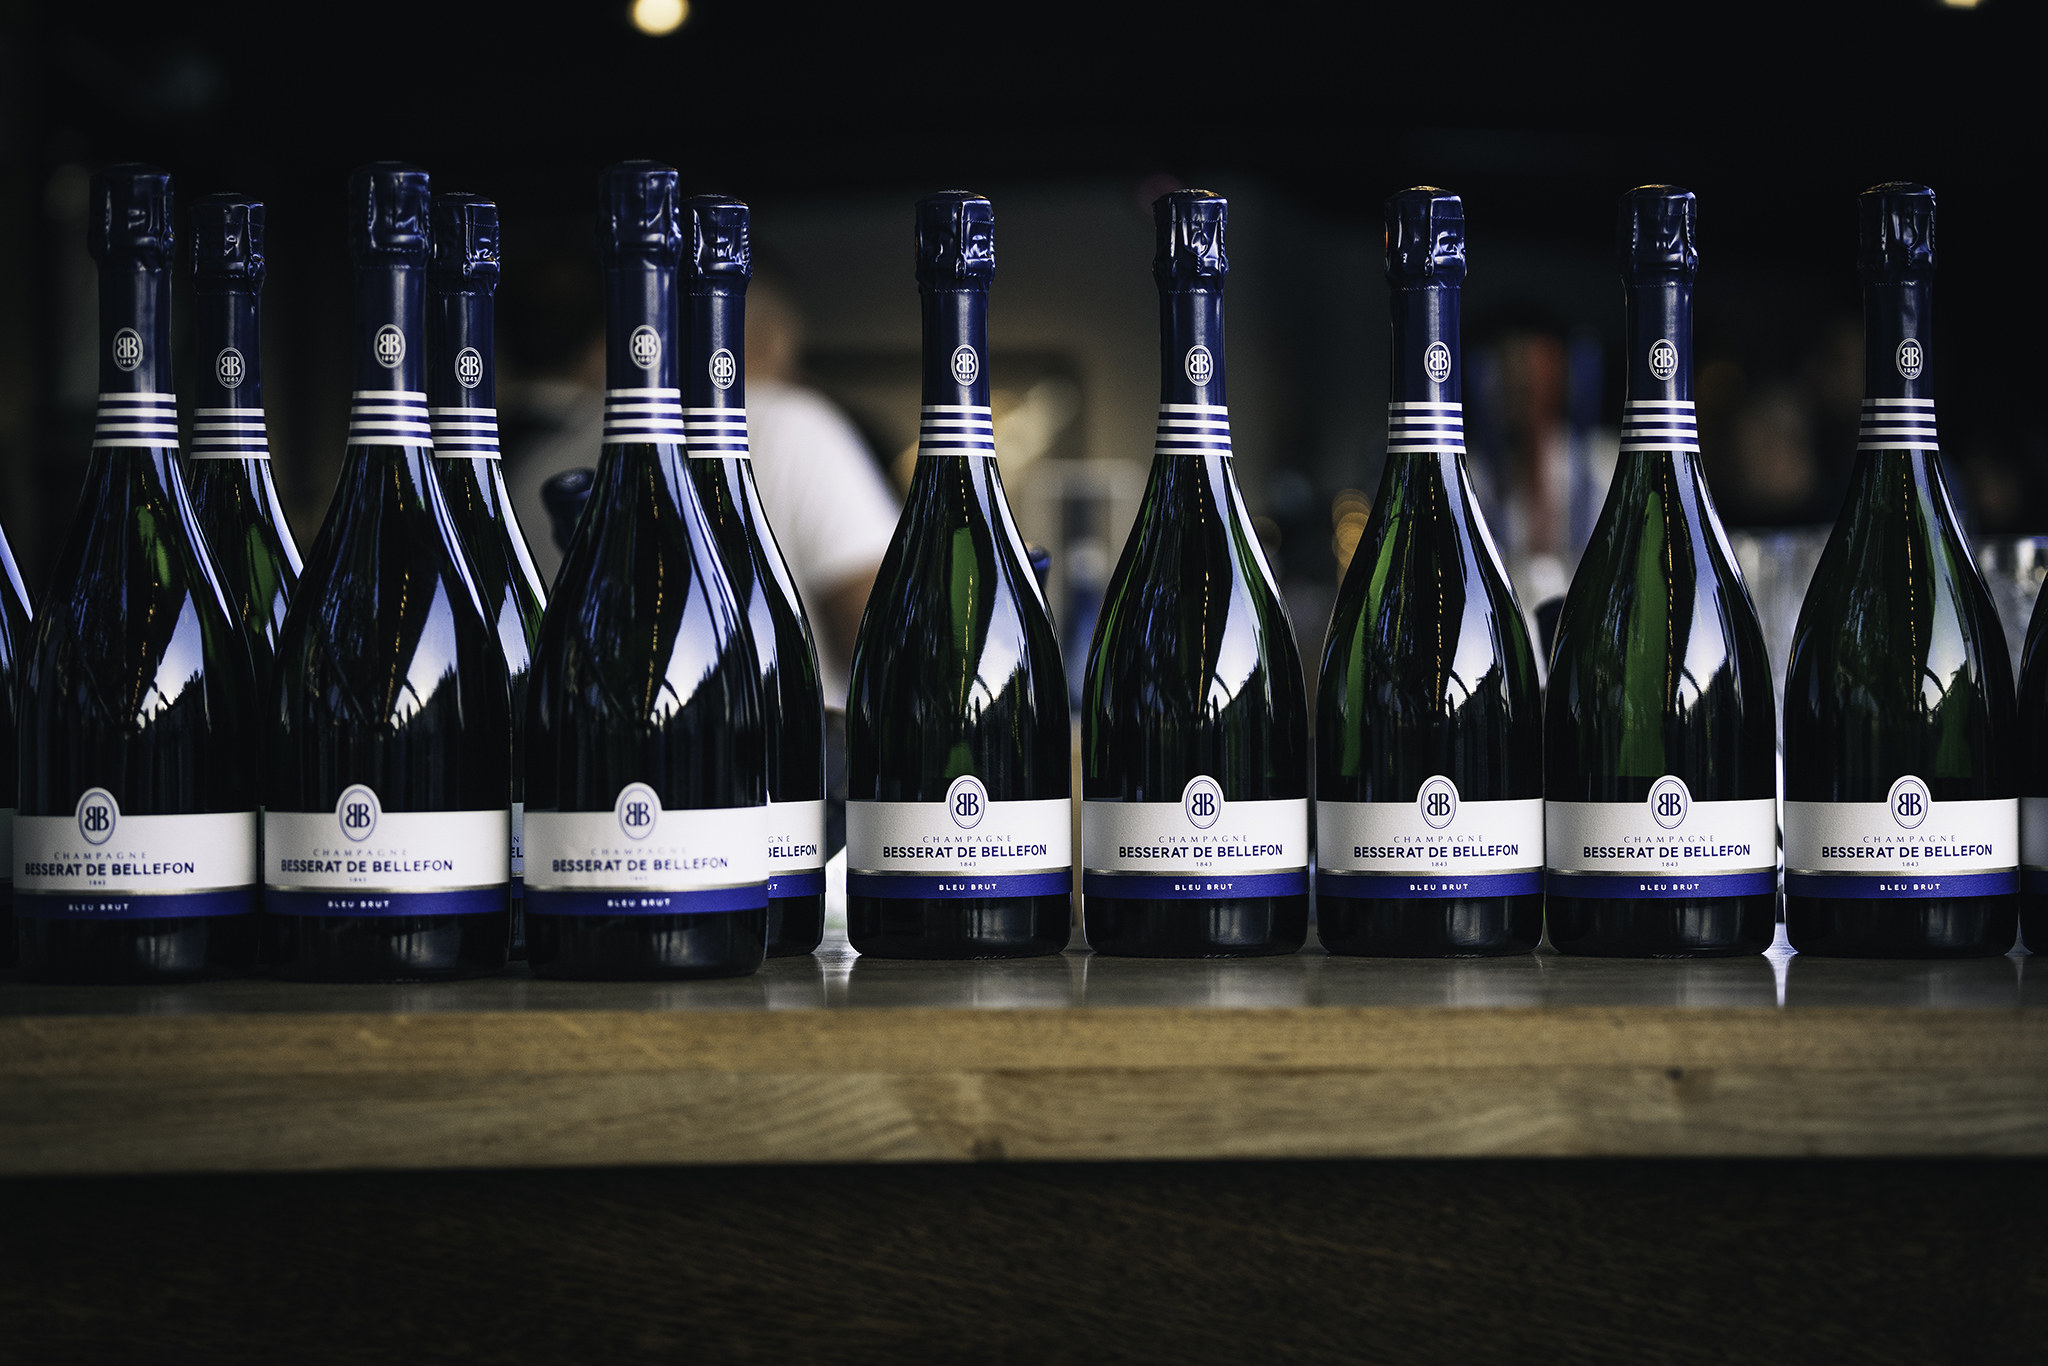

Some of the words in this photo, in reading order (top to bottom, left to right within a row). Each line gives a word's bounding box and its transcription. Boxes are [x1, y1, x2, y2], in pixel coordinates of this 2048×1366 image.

[923, 835, 1011, 843] CHAMPAGNE
[1159, 835, 1247, 843] CHAMPAGNE
[1394, 835, 1482, 843] CHAMPAGNE
[1624, 835, 1714, 843] CHAMPAGNE
[1863, 835, 1955, 843] CHAMPAGNE
[54, 851, 146, 860] CHAMPAGNE
[883, 847, 953, 858] BESSERAT
[957, 847, 976, 857] DE
[982, 844, 1046, 857] BELLEFON
[1119, 847, 1189, 858] BESSERAT
[1193, 847, 1212, 857] DE
[1218, 844, 1282, 857] BELLEFON
[1354, 847, 1424, 858] BESSERAT
[1429, 847, 1448, 857] DE
[1453, 844, 1518, 857] BELLEFON
[1583, 847, 1654, 858] BESSERAT
[1659, 847, 1678, 857] DE
[1684, 844, 1750, 857] BELLEFON
[1822, 846, 1894, 858] BESSERAT
[1899, 847, 1918, 857] DE
[1925, 844, 1992, 857] BELLEFON
[25, 863, 82, 876] BESSERAT
[87, 863, 106, 876] DE
[112, 862, 194, 875] BELLEFON
[281, 859, 342, 872] BESSERAT
[347, 860, 366, 872] DE
[373, 859, 453, 872] BELLEFON
[552, 859, 622, 872] BESSERAT
[627, 859, 647, 871] DE
[654, 858, 728, 871] BELLEFON
